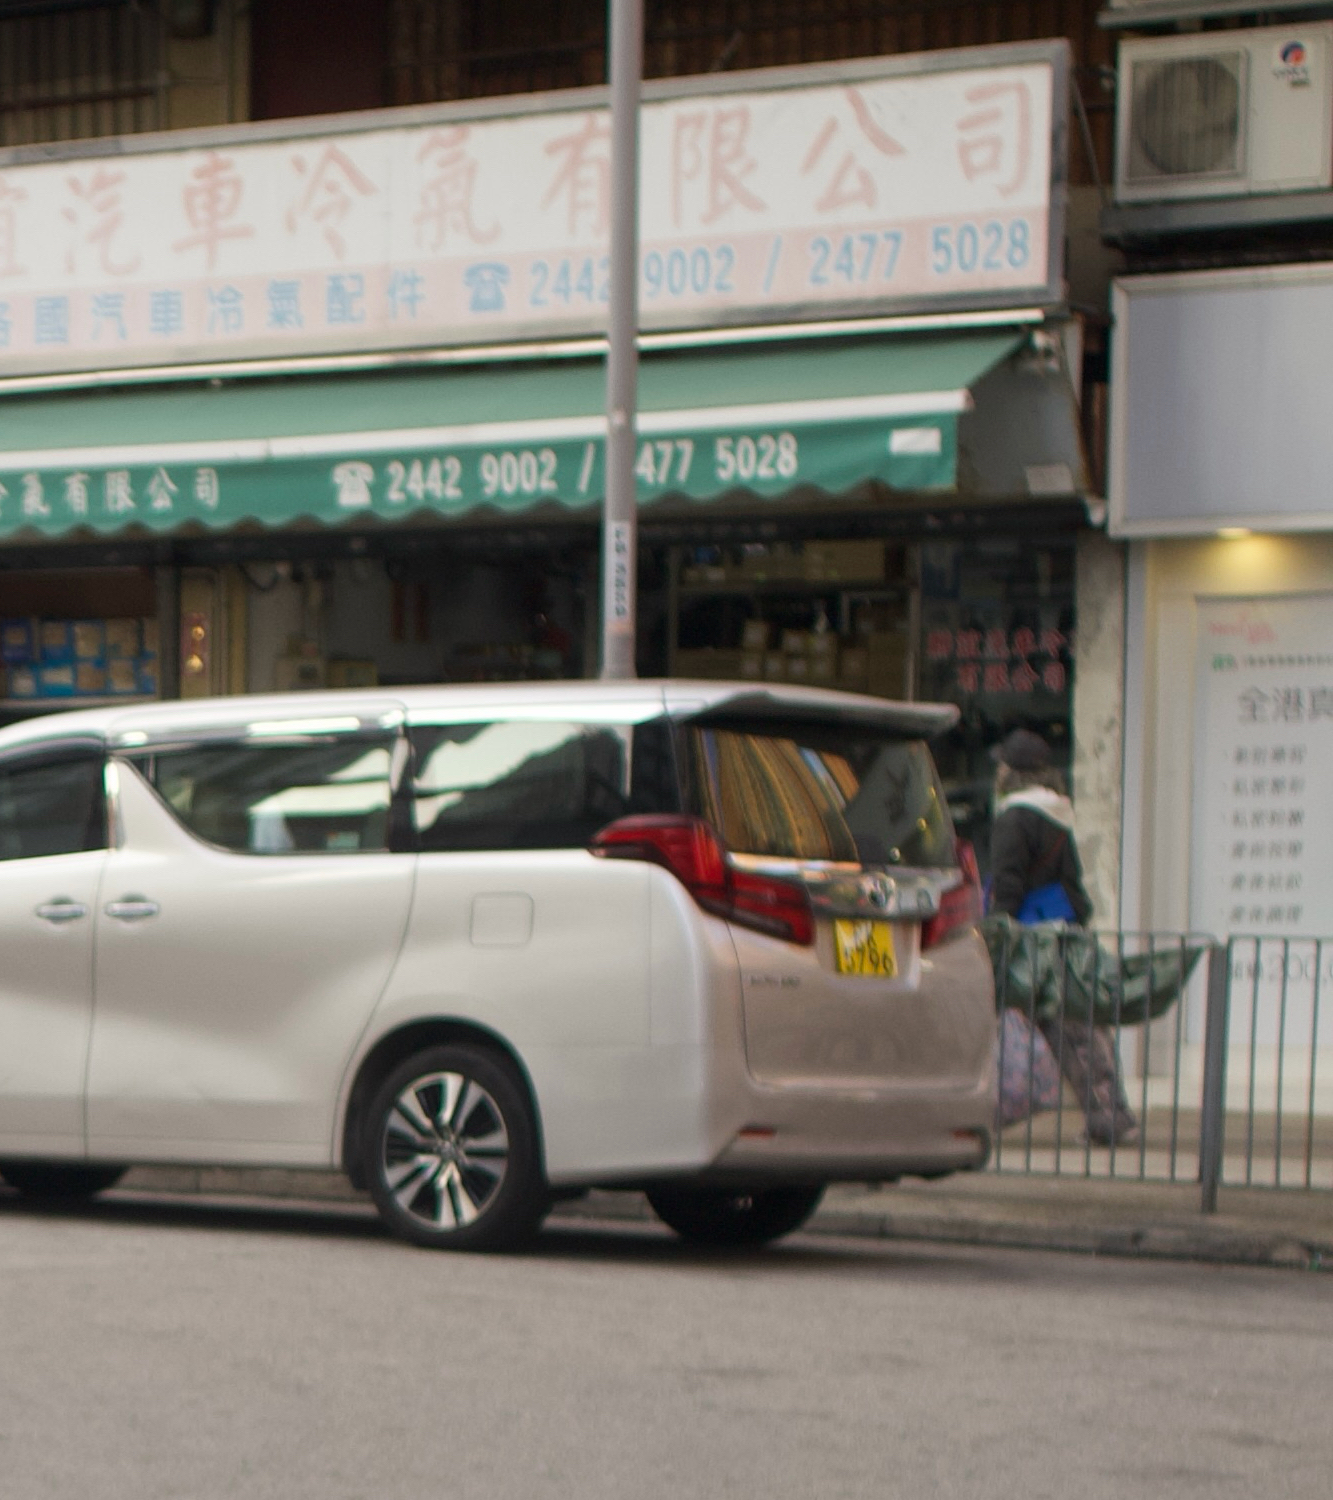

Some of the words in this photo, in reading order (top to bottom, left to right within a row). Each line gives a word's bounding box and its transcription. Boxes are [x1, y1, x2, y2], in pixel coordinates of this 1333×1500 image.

[644, 244, 735, 297] 9002
[809, 230, 904, 286] 2477
[932, 217, 1032, 275] 5028
[387, 455, 463, 501] 2442
[481, 447, 559, 496] 9002
[715, 431, 799, 480] 5028
